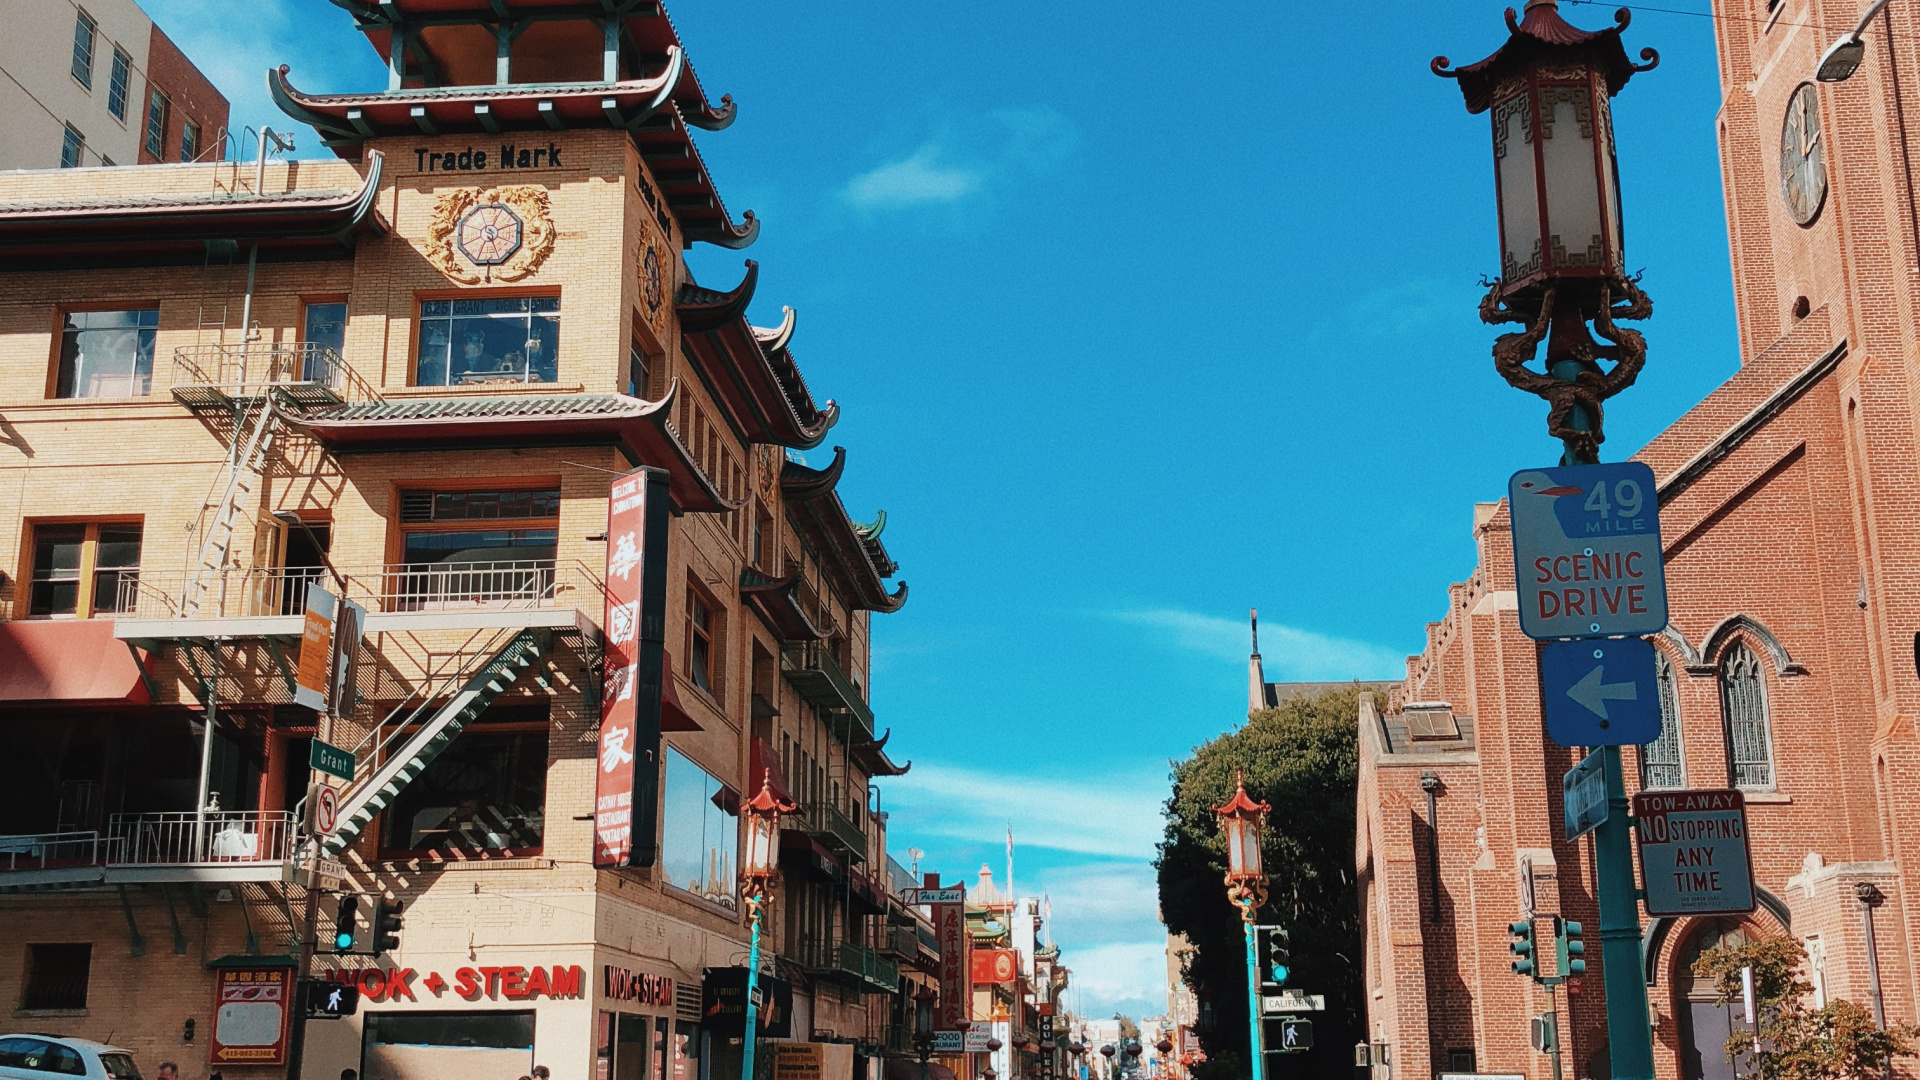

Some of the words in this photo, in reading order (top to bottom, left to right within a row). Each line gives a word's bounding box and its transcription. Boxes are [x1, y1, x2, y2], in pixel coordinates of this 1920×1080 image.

[414, 146, 487, 172] Trade
[500, 143, 562, 169] Mark
[638, 163, 656, 212] Trade
[425, 302, 448, 315] 625
[454, 300, 486, 314] GRANT
[612, 479, 637, 500] WELCOME
[1584, 479, 1643, 519] 49
[613, 493, 643, 515] CHINATOWN
[1585, 518, 1646, 533] MILE
[1534, 551, 1644, 584] SCENIC
[1538, 584, 1648, 619] DRIVE
[320, 749, 348, 773] Grant
[617, 791, 632, 807] HOUSE
[1642, 795, 1734, 811] TOW-AWAY
[597, 808, 632, 828] RESTAURANT
[1640, 815, 1668, 842] NO
[1671, 818, 1741, 841] STOPPING
[1675, 846, 1715, 868] ANY
[322, 863, 344, 877] GRANT
[1674, 871, 1723, 893] TIME
[920, 891, 935, 901] Far
[938, 890, 960, 901] East
[454, 965, 581, 997] STEAM
[606, 965, 632, 1001] WOK
[641, 972, 673, 1007] STEAM
[1269, 999, 1320, 1008] CALIFORNIA
[934, 1033, 960, 1041] FOOD
